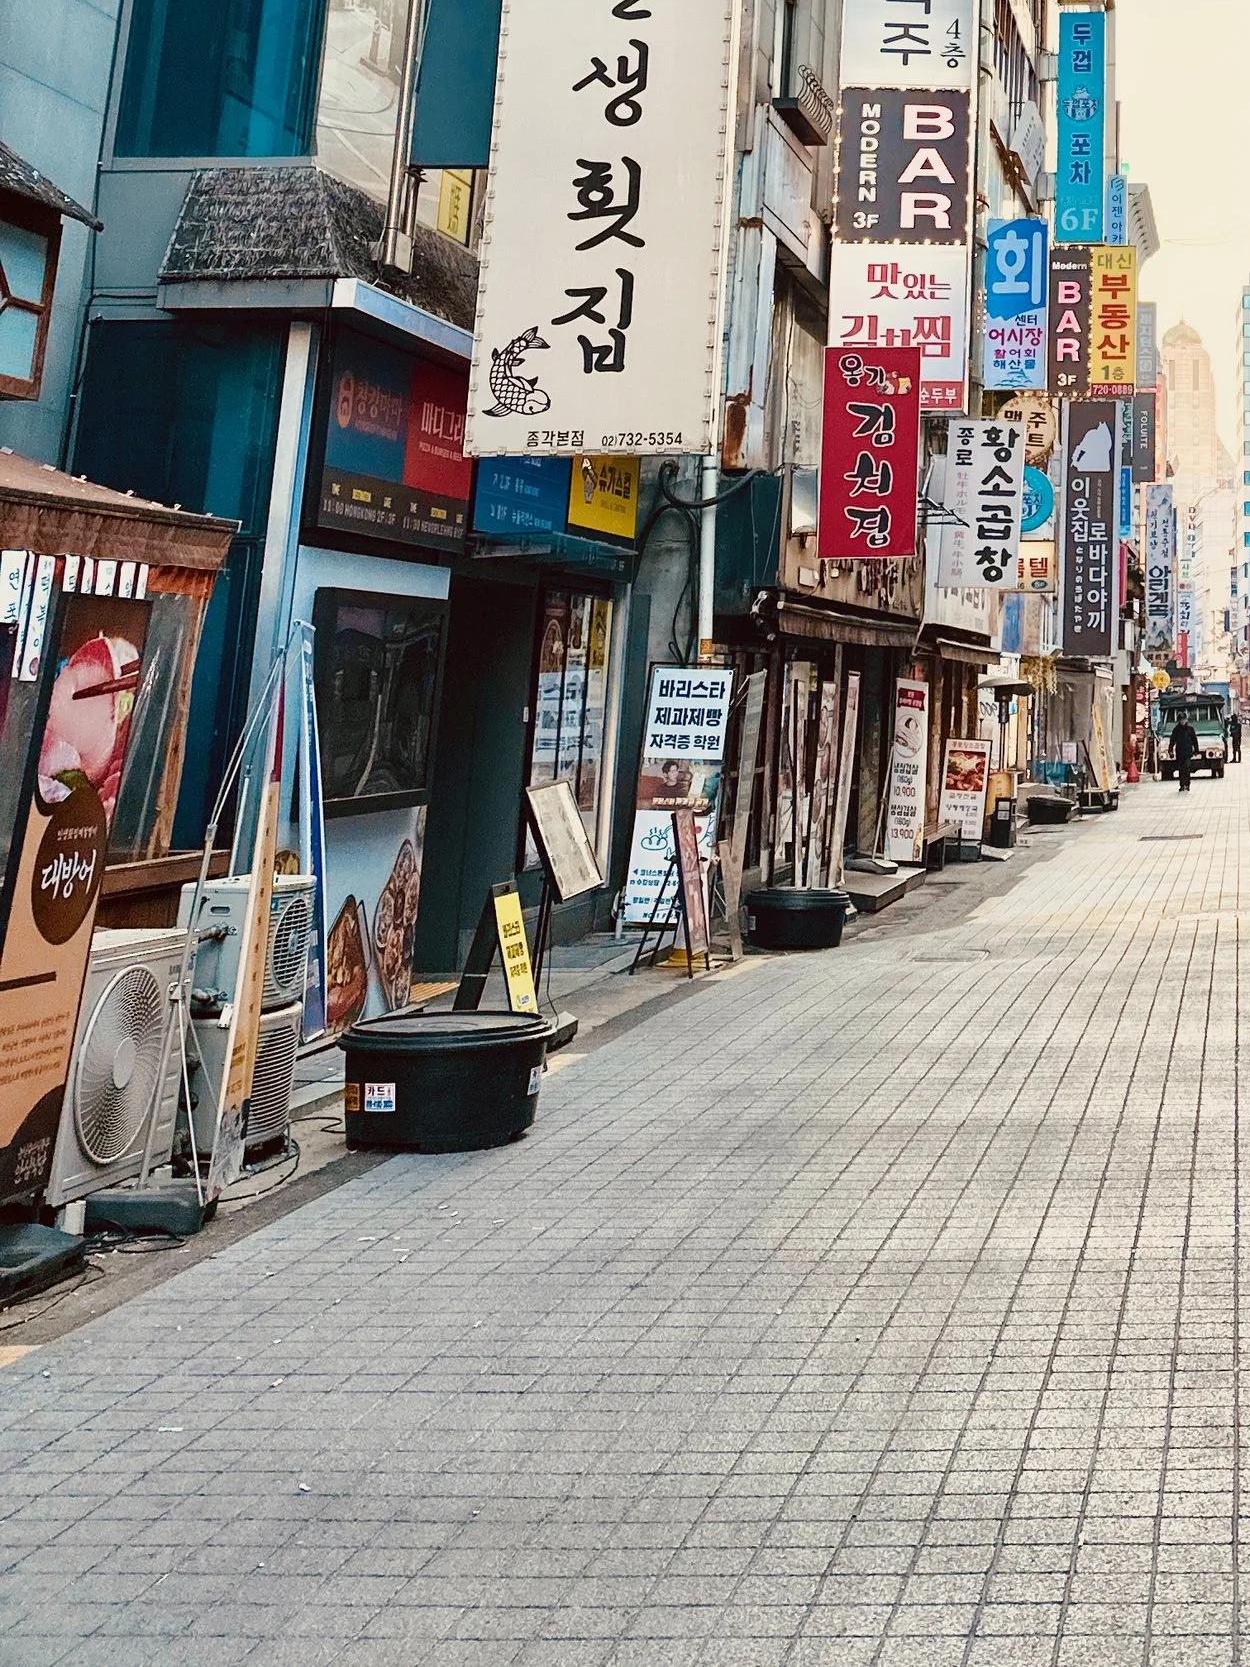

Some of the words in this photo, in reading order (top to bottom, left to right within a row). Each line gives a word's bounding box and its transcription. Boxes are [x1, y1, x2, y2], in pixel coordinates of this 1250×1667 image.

[940, 17, 967, 69] 4층
[1071, 22, 1093, 74] 두껍
[857, 102, 883, 204] MODERN
[897, 103, 956, 230] BAR
[1069, 133, 1092, 185] 포차
[853, 212, 880, 230] 3F
[1060, 207, 1099, 231] 6F
[991, 228, 1043, 306] 회
[1052, 262, 1088, 272] Modern
[1097, 254, 1133, 270] 대신
[867, 262, 953, 301] 맛있는
[1014, 314, 1038, 327] 센터
[1056, 281, 1082, 362] BAR
[1095, 273, 1131, 360] 부동산
[988, 327, 1043, 347] 어시장
[993, 348, 1036, 359] 활어회
[838, 354, 886, 386] 옹기
[992, 359, 1036, 370] 해산물
[1056, 372, 1078, 387] 3F
[525, 429, 585, 448] 종각본점
[601, 430, 684, 448] 02)732-5354
[955, 427, 975, 466] 종로
[973, 425, 1020, 583] 황소곱창
[1070, 477, 1091, 543] 이웃집
[1086, 522, 1109, 634] 로바다야끼
[658, 679, 726, 700] 바리스타
[653, 707, 724, 728] 제과제빵
[649, 733, 691, 750] 자격증
[692, 734, 721, 751] 학원
[41, 848, 98, 901] 대방어
